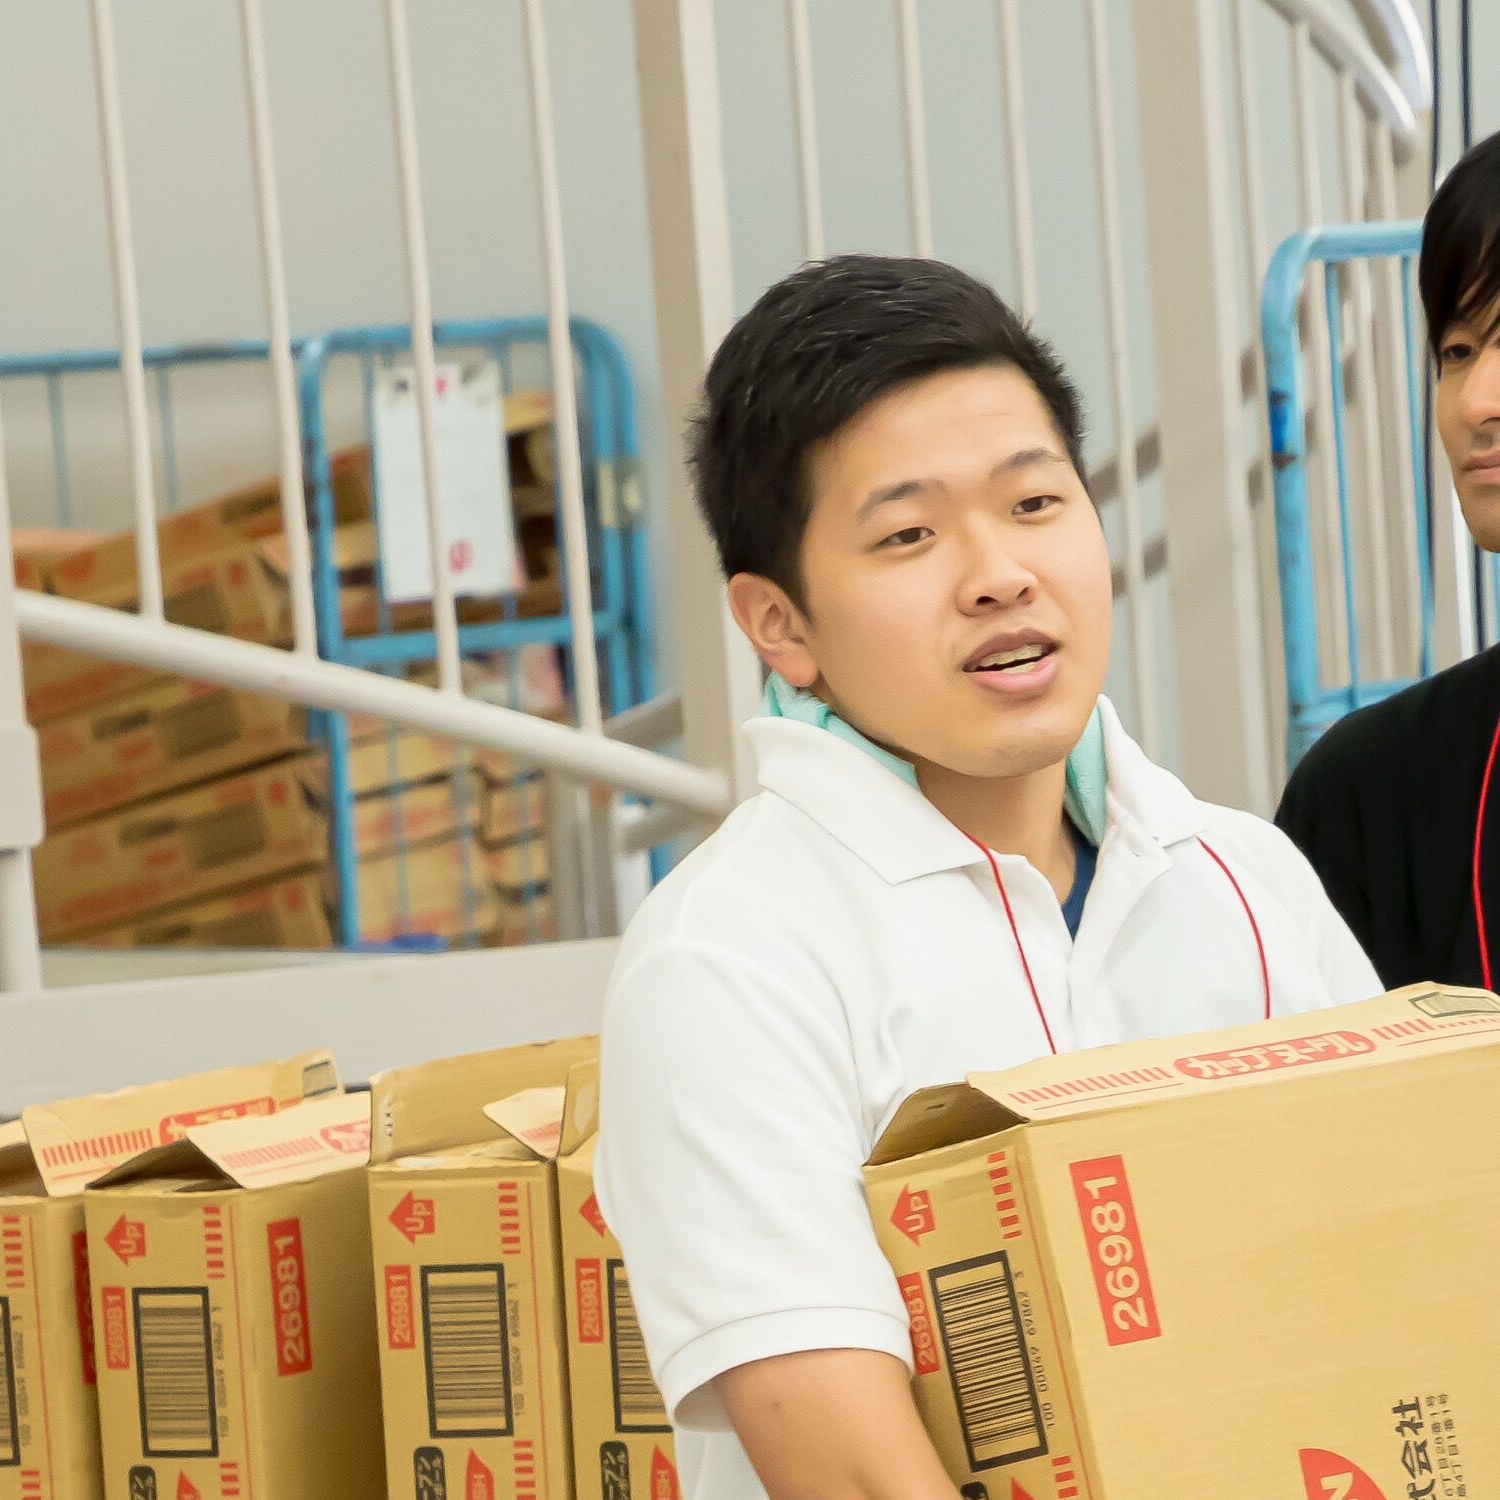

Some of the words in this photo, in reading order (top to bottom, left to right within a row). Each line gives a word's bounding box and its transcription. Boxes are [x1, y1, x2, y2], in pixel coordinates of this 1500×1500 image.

[1185, 1032, 1369, 1079] カップヌードル
[405, 1202, 434, 1232] Up
[1083, 1174, 1150, 1332] 26981
[273, 1235, 306, 1366] 26981
